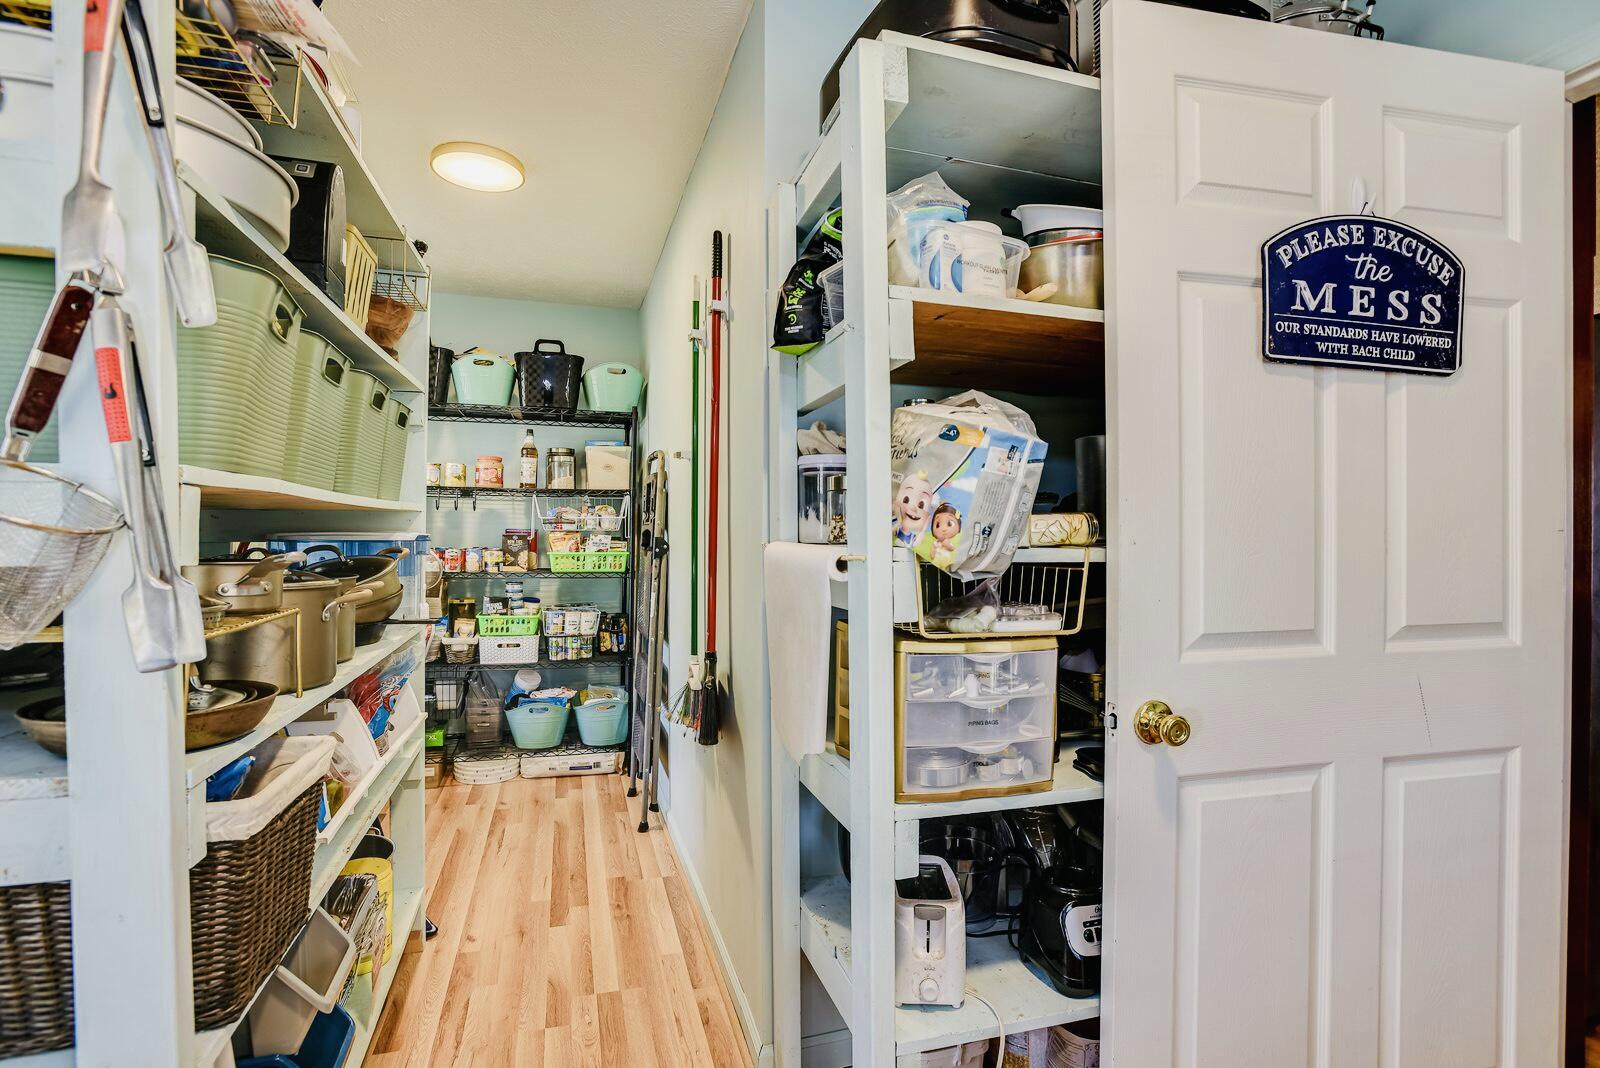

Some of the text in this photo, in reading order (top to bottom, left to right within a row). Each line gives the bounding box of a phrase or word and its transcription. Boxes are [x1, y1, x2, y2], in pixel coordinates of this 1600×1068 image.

[1275, 224, 1455, 286] PLEASE EXCUSE
[1344, 252, 1394, 282] the
[1275, 321, 1452, 349] OUR STANDARDS HAVE LOWERED
[1315, 341, 1416, 361] WITH EACH CHILD
